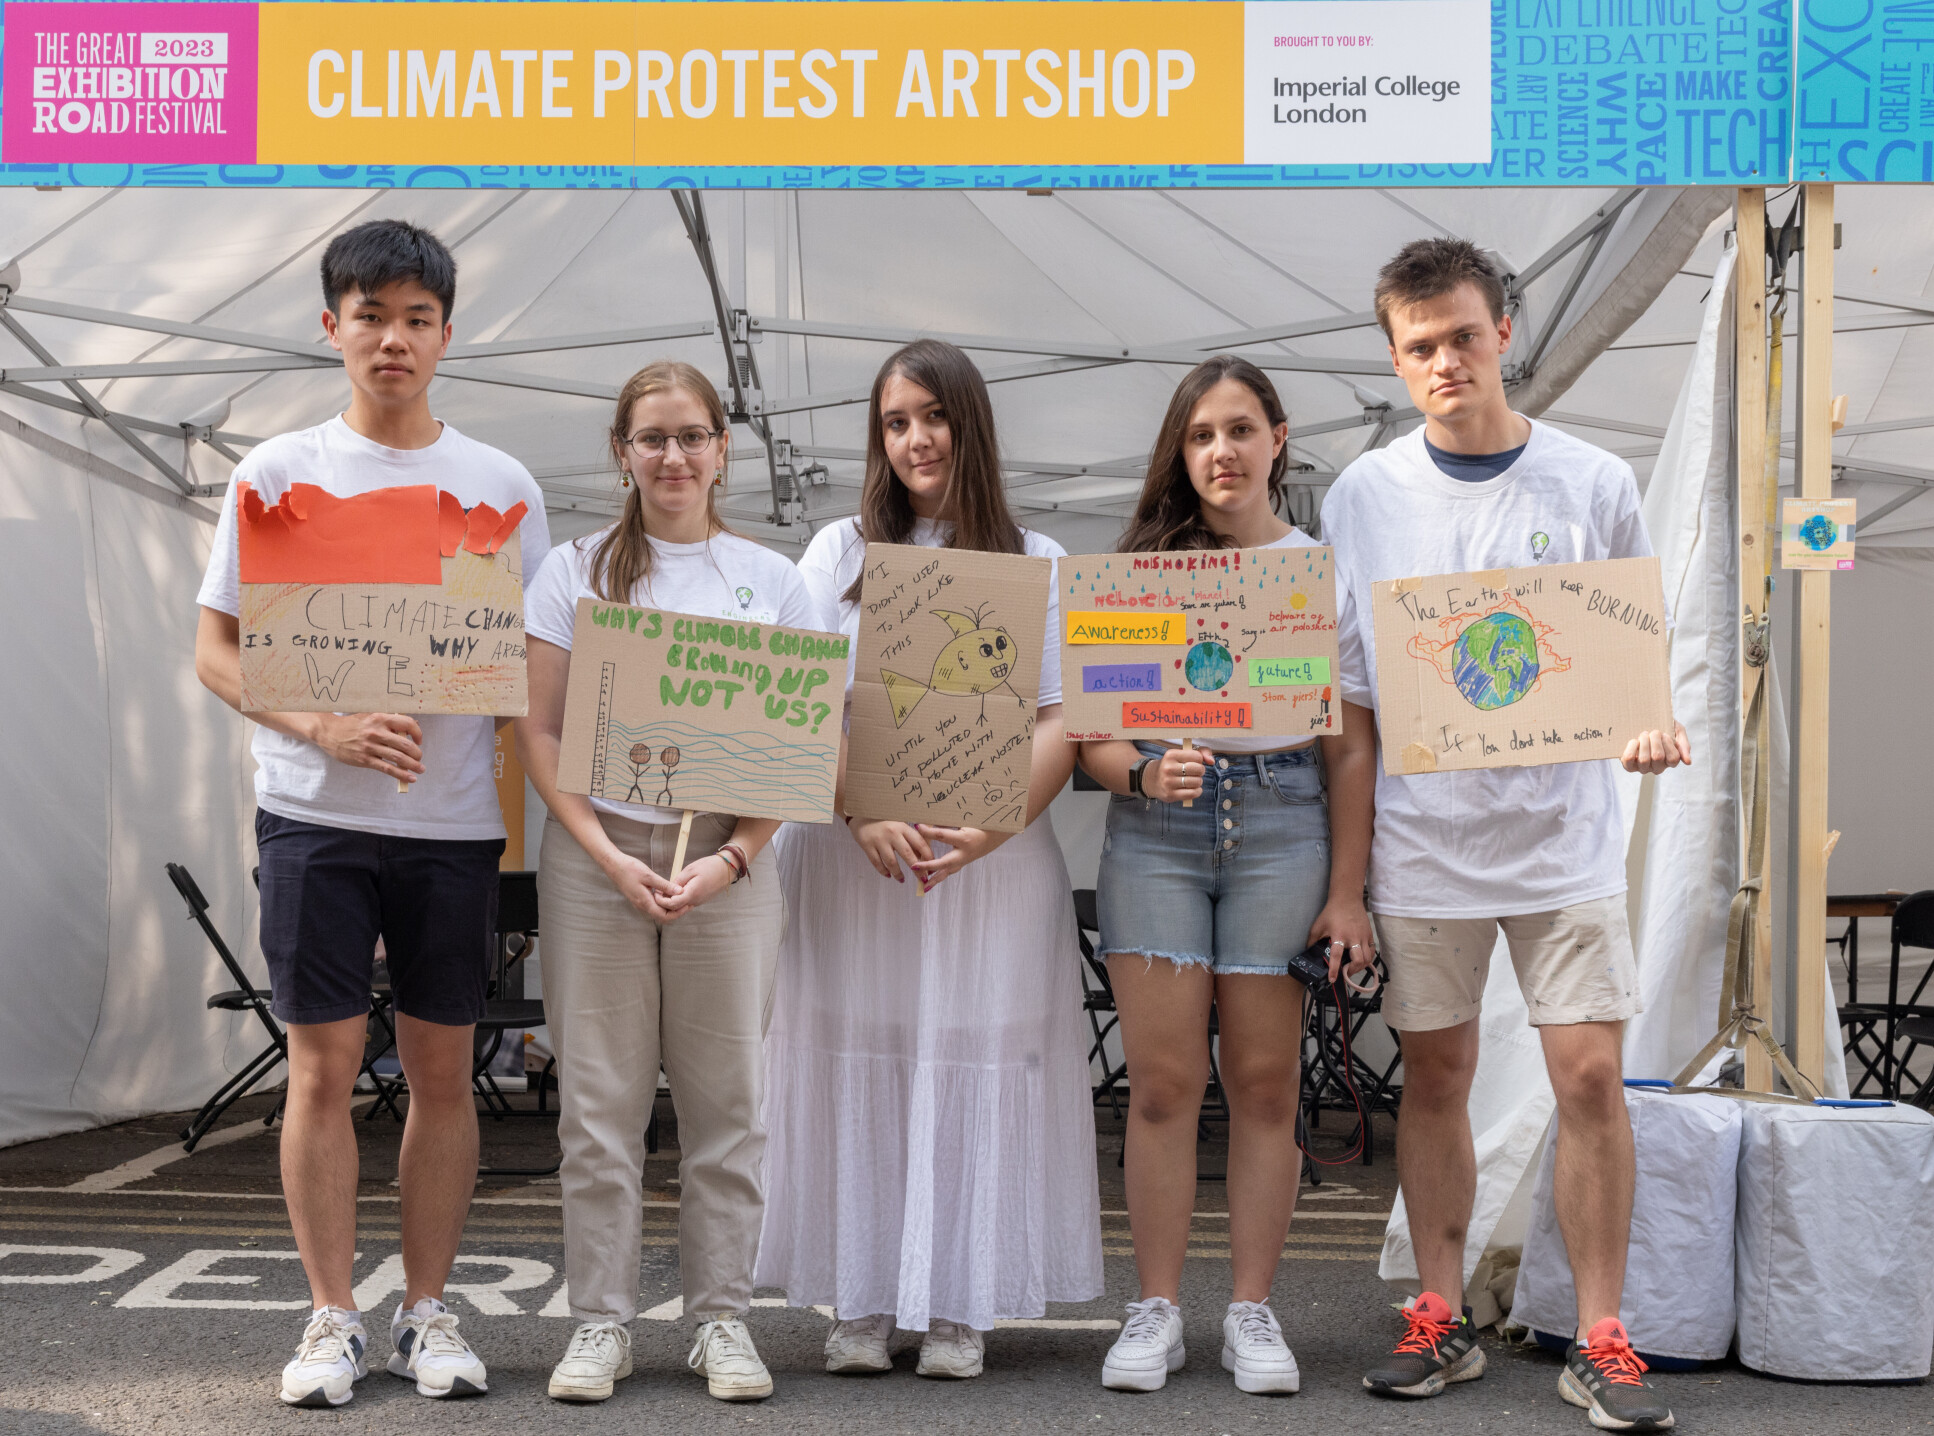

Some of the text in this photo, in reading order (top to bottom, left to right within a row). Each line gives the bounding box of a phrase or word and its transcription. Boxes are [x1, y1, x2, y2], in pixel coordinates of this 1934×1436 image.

[35, 32, 137, 65] THE GREAT
[154, 39, 214, 57] 2023
[1274, 35, 1374, 47] BROUGHT TO YOU BY:
[1516, 32, 1708, 66] DEBATE
[33, 67, 228, 99] EXHIBITION
[307, 48, 1196, 119] CLIMATE PROTEST ARTSHOP
[1274, 75, 1461, 103] Imperial College
[1517, 74, 1547, 103] ART
[1675, 70, 1747, 100] MAKE
[1879, 62, 1911, 133] CREATE
[33, 101, 227, 135] ROAD FESTIVAL
[1274, 103, 1367, 124] London
[1557, 72, 1589, 179] SCIENCE
[1596, 70, 1628, 178] WHY
[1675, 108, 1787, 178] TECH
[912, 559, 939, 584] USED
[305, 588, 460, 636] CLIMATE
[1396, 591, 1439, 622] The
[1447, 587, 1498, 614] Earth
[1515, 578, 1543, 598] will
[1587, 588, 1659, 636] BURNING
[1071, 620, 1170, 641] Awareness!
[244, 634, 273, 649] IS
[292, 635, 392, 655] GROWING
[430, 635, 479, 664] WHY
[880, 635, 912, 660] THIS
[659, 674, 744, 710] NOT
[777, 667, 830, 698] UP
[764, 694, 831, 734] US?
[885, 734, 925, 767] UNTIL
[1542, 728, 1564, 744] take
